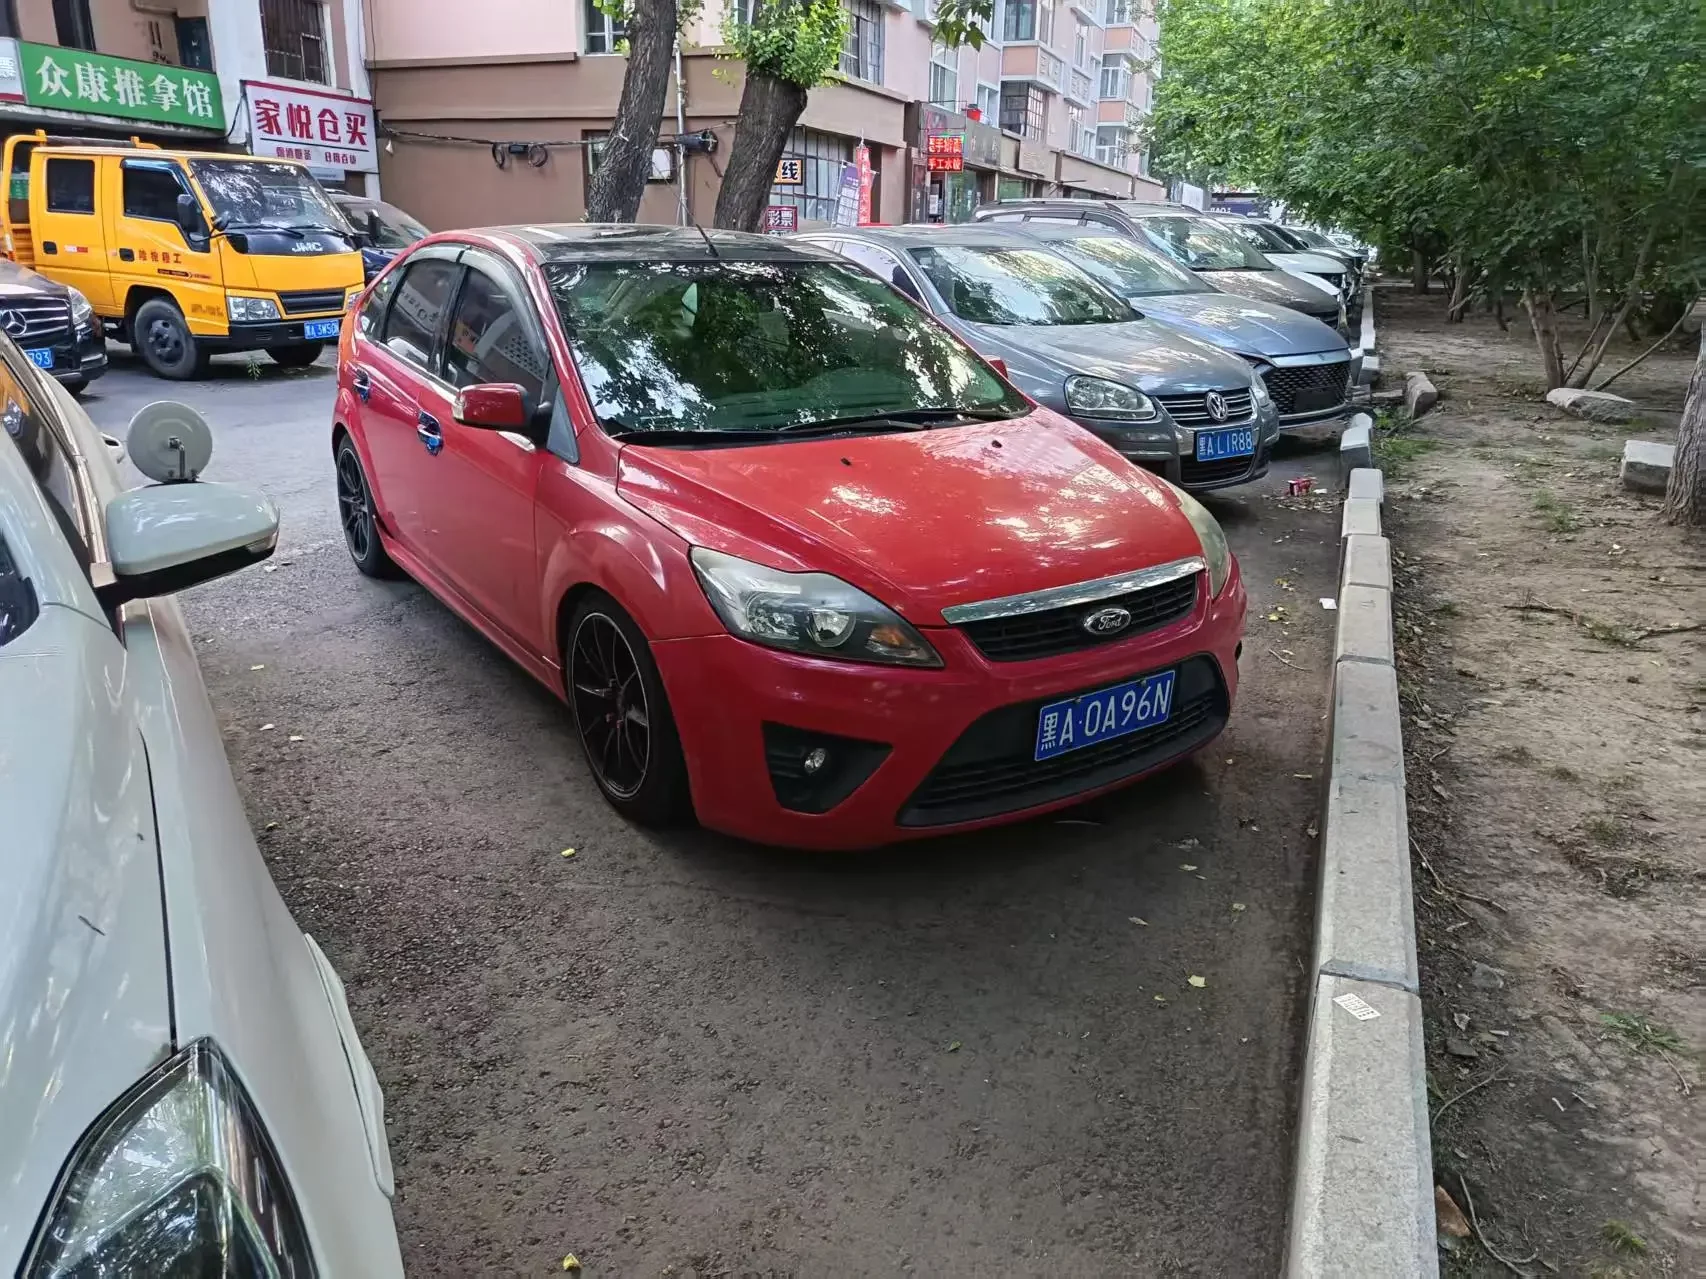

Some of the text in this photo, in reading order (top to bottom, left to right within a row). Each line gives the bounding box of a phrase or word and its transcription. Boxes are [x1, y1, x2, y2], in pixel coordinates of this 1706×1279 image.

[36, 56, 213, 118] 众康推拿馆
[254, 99, 367, 145] 家悦仓买
[776, 162, 798, 180] 线
[768, 210, 793, 226] 彩票
[292, 242, 323, 252] JMC
[1098, 614, 1122, 630] Ford
